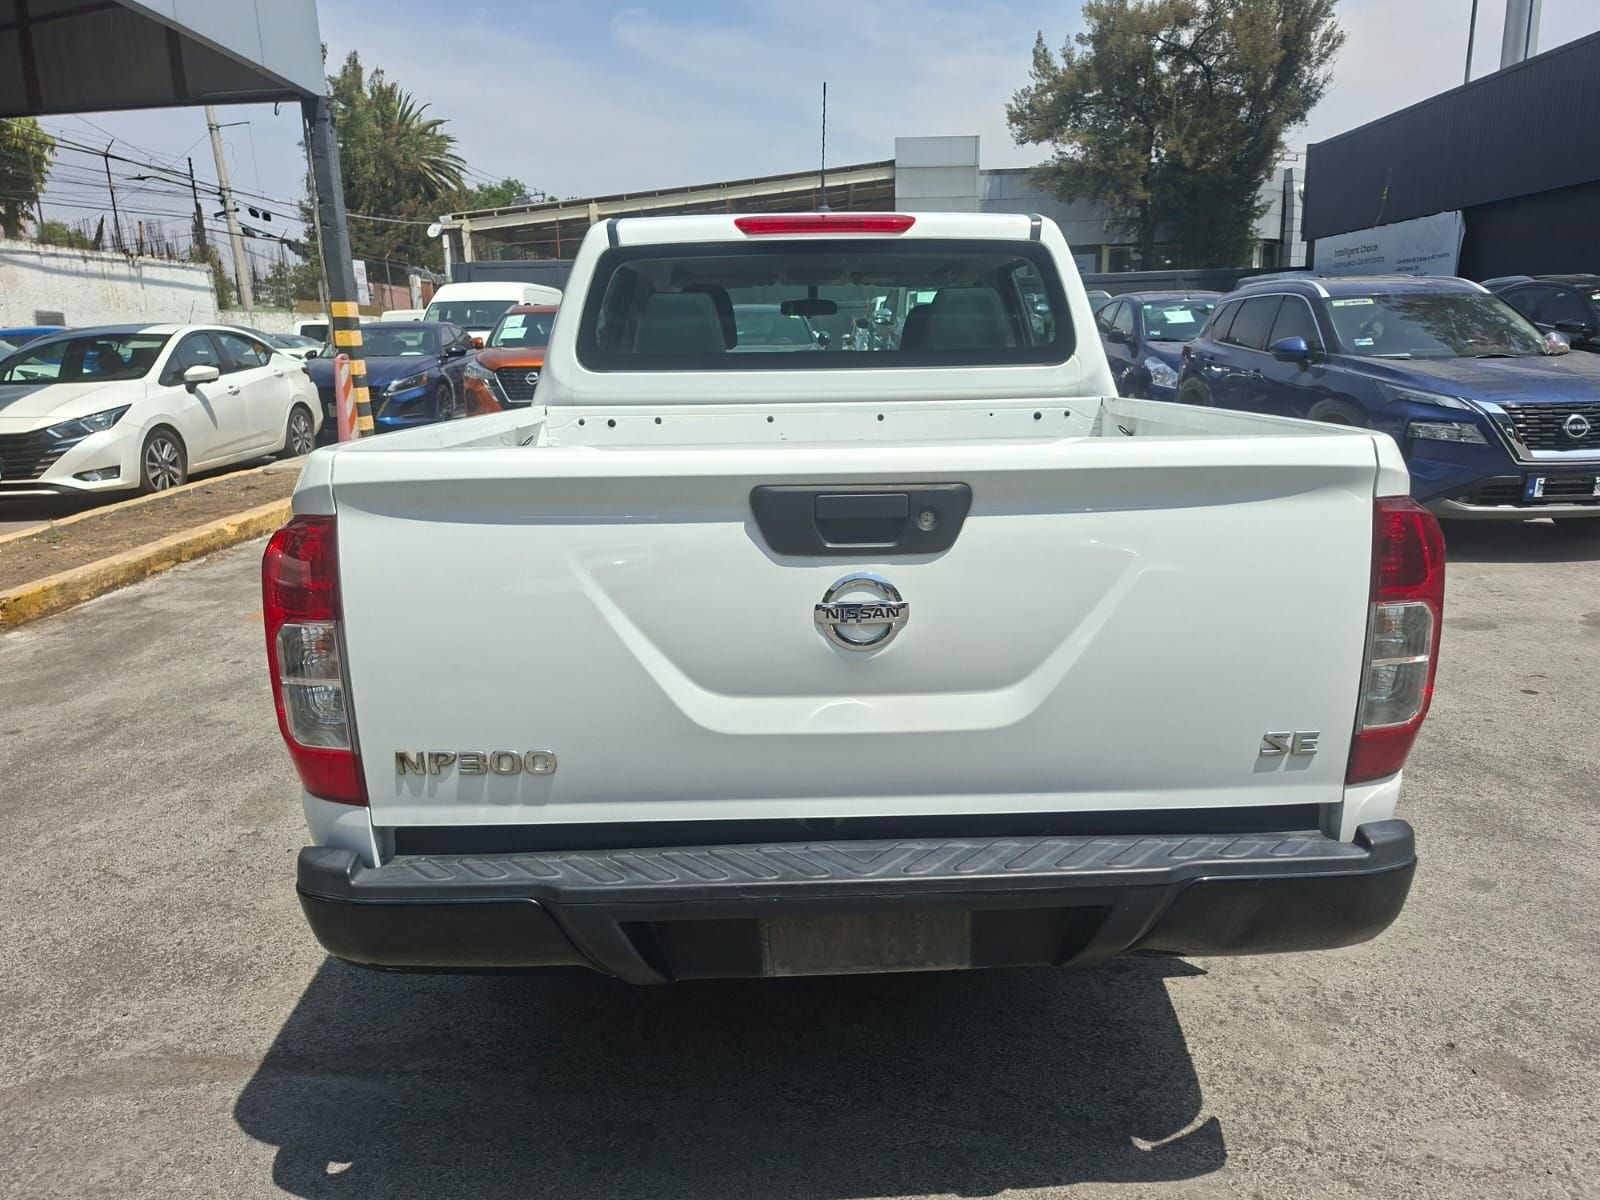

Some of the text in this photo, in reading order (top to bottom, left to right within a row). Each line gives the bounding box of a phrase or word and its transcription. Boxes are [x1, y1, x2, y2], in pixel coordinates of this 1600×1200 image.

[1360, 244, 1378, 254] Choice
[825, 608, 900, 620] NISSAN
[1260, 730, 1320, 756] SE
[395, 750, 558, 776] NP300
